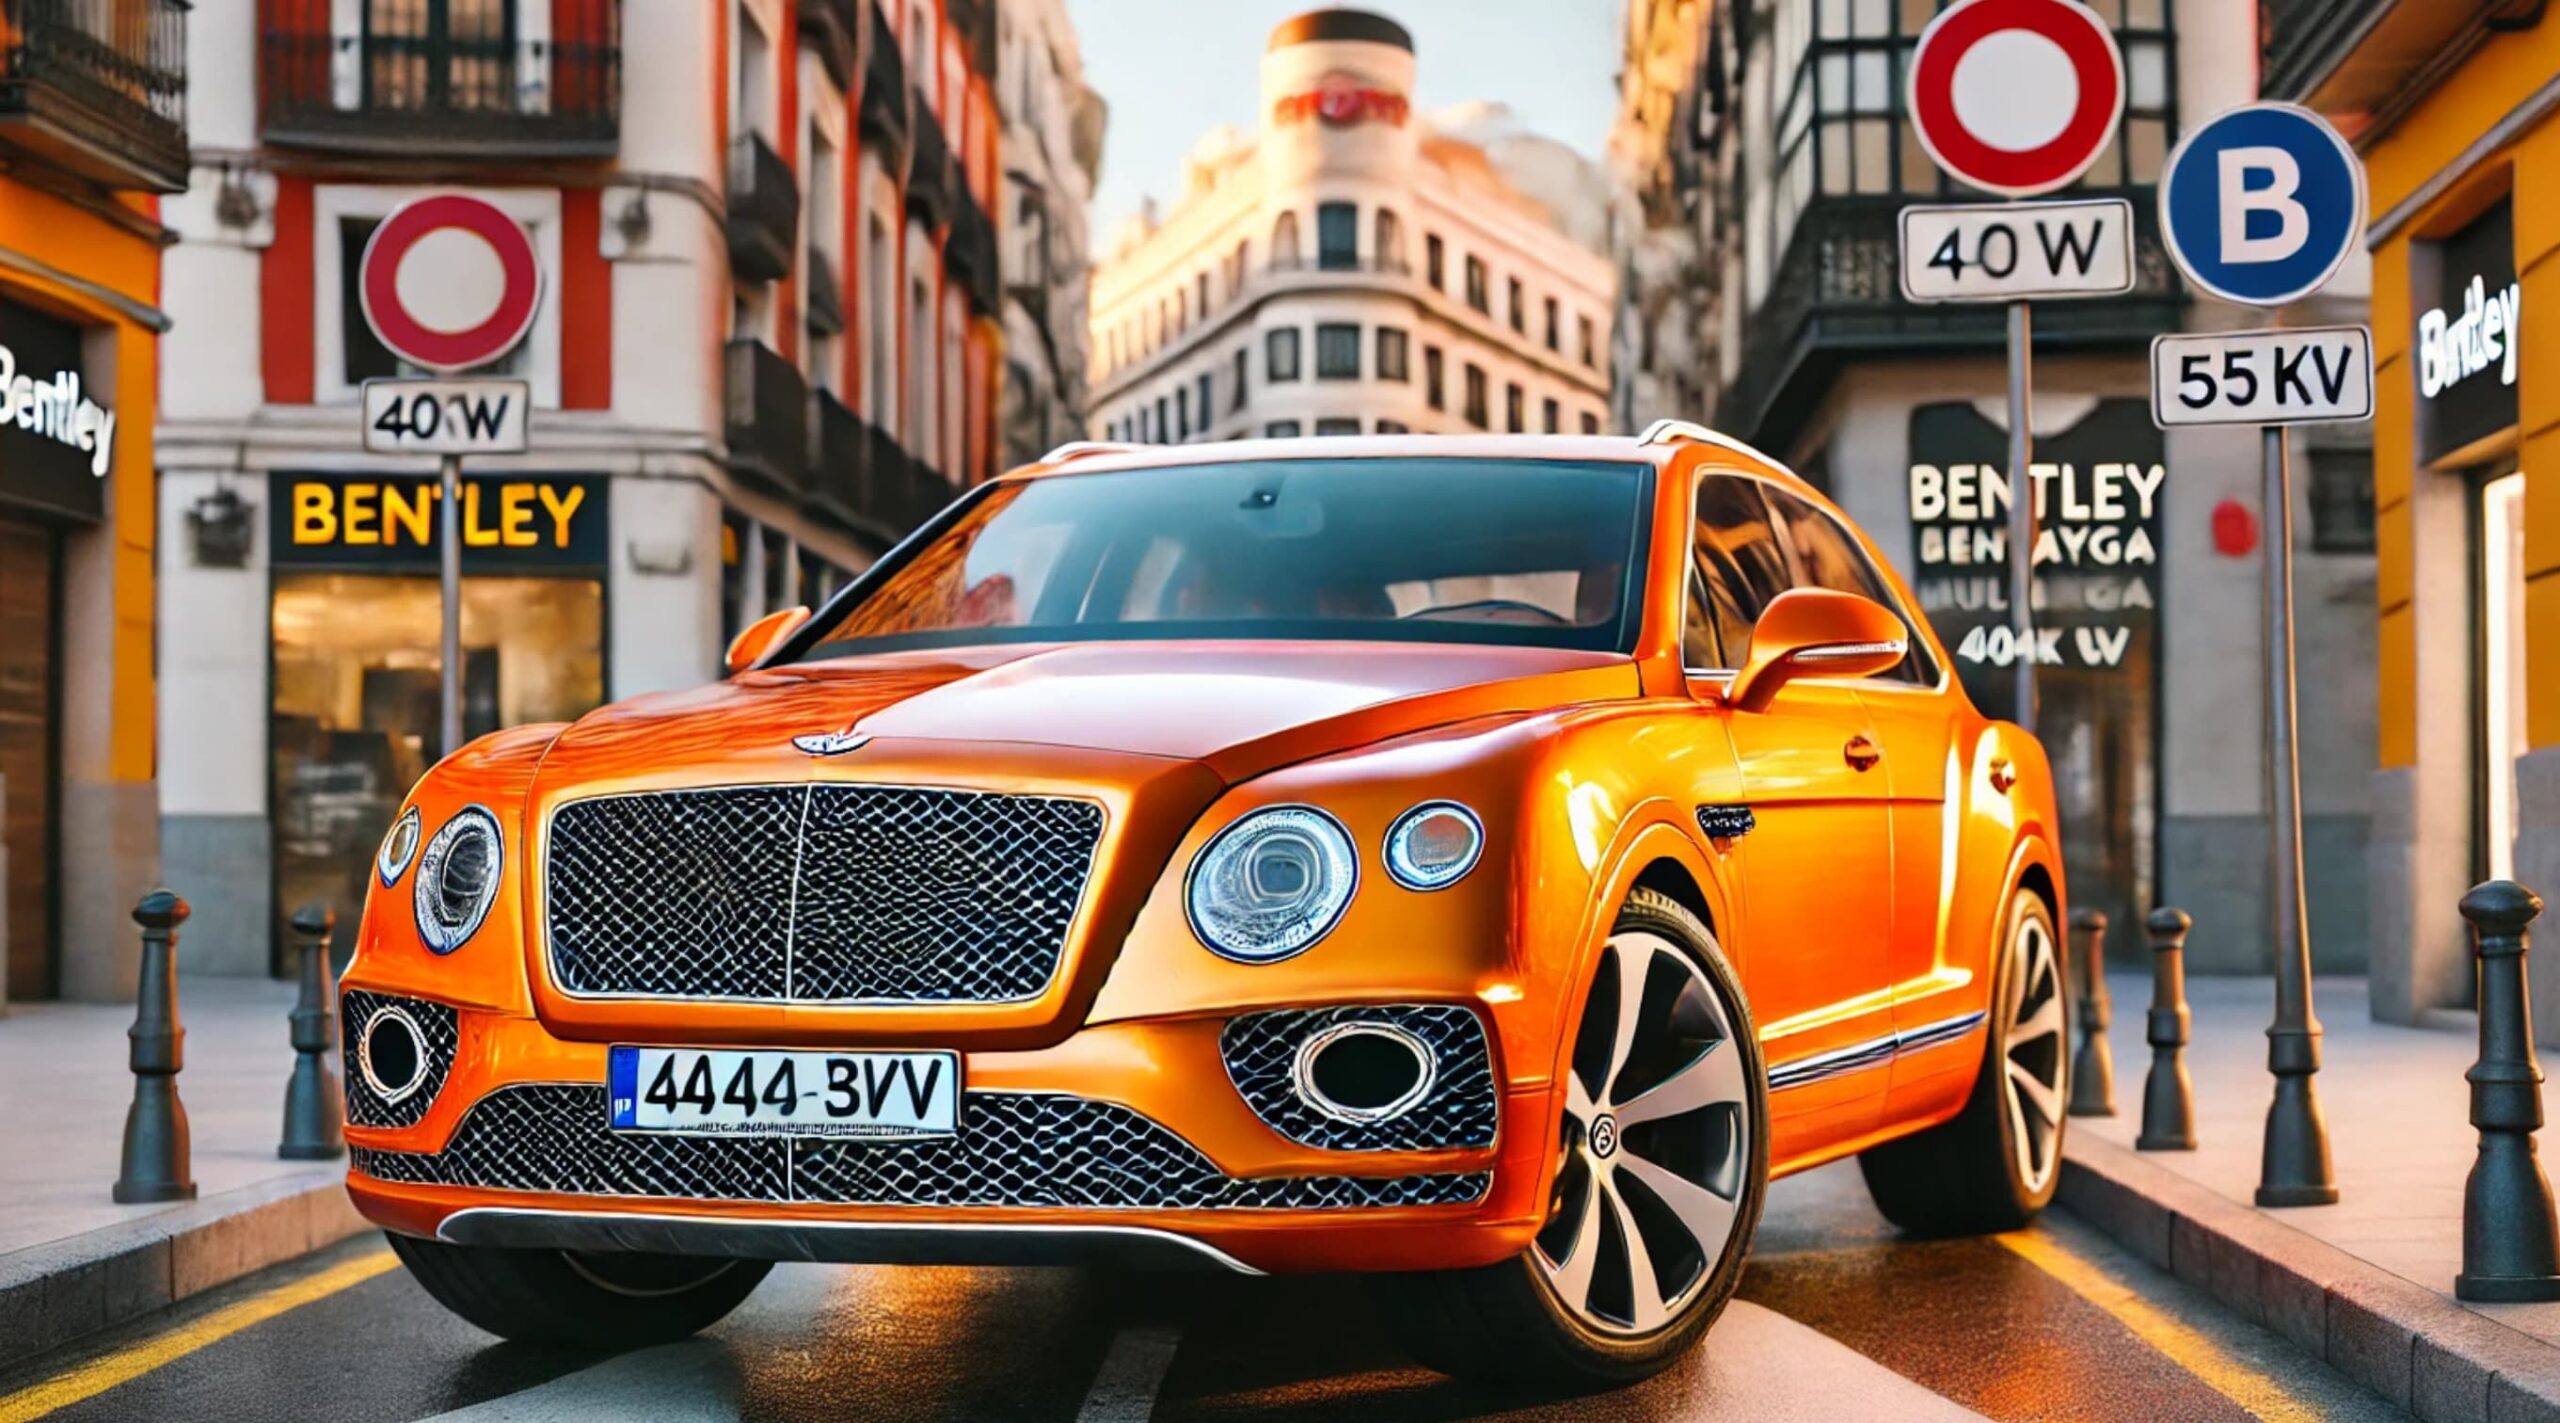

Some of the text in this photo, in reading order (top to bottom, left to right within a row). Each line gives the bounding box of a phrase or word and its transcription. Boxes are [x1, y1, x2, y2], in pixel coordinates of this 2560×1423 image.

[2217, 146, 2310, 264] B
[1928, 219, 2103, 281] 40 W
[2179, 344, 2352, 409] 55 KV
[293, 482, 585, 547] BENLEY
[1921, 525, 2156, 566] BENAYGA
